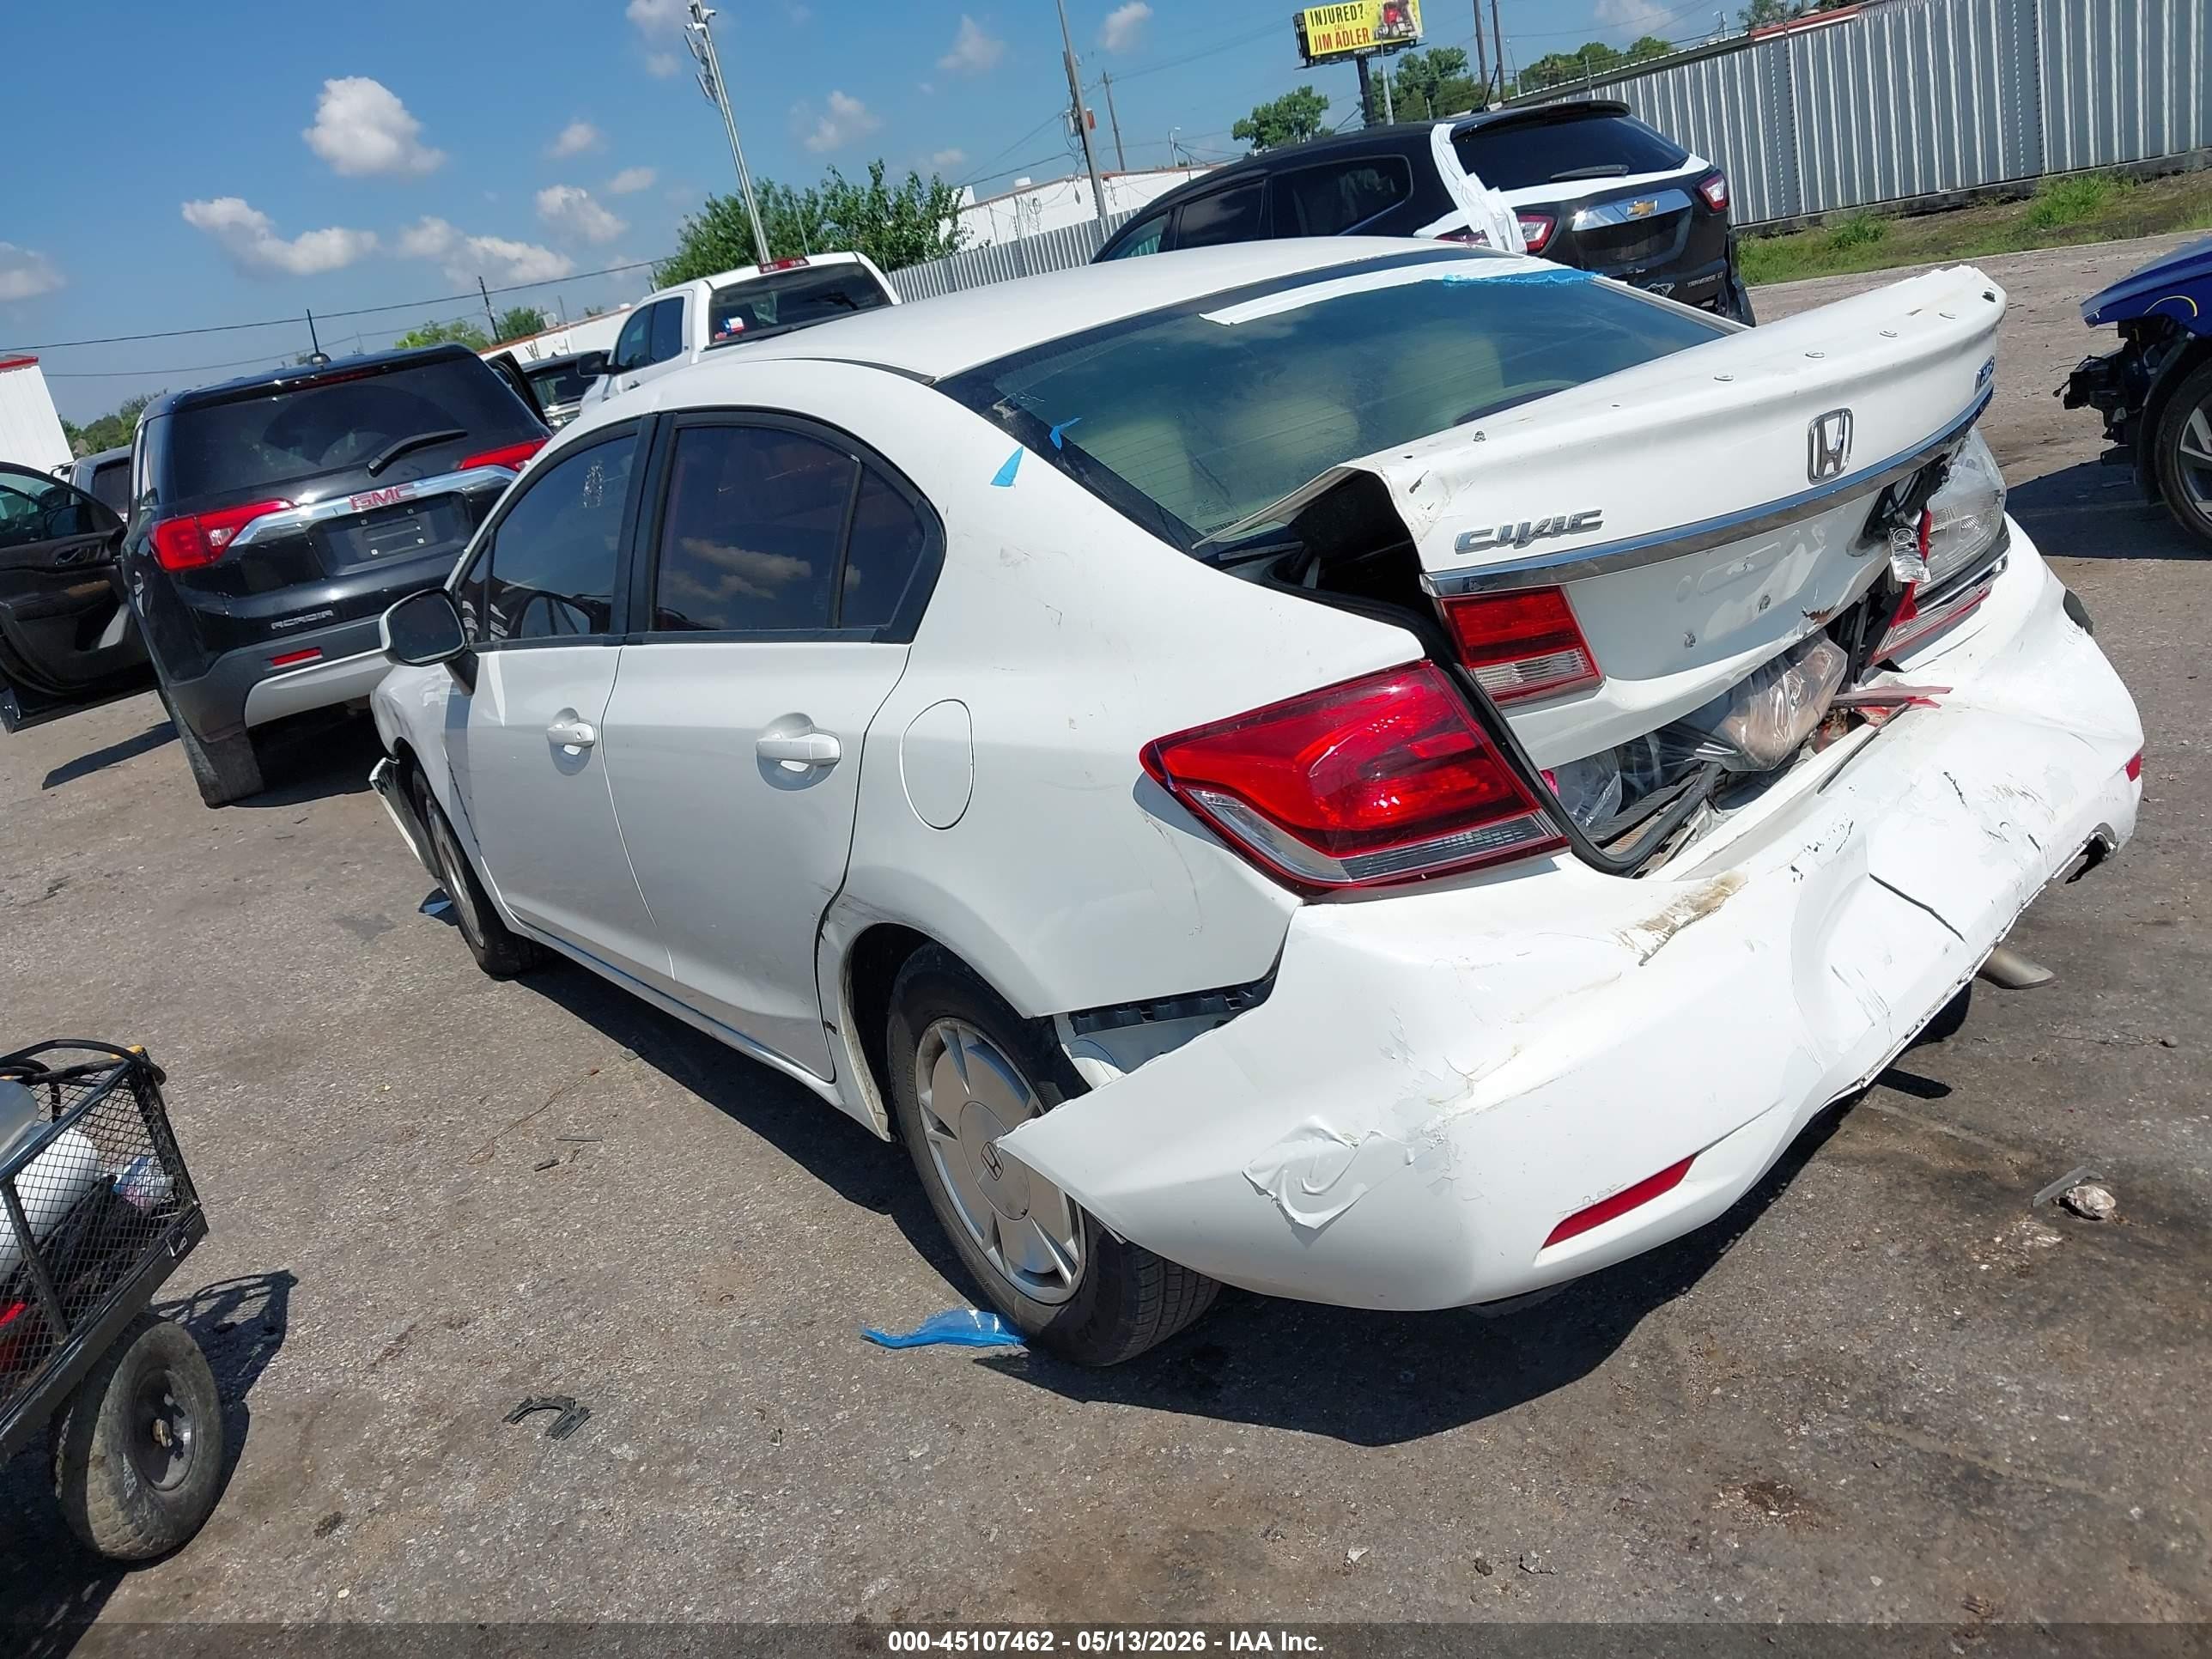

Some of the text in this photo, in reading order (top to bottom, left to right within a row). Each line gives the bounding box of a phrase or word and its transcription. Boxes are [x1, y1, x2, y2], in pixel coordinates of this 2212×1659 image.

[1310, 3, 1364, 27] INJURED?
[1334, 22, 1346, 31] CALL
[1314, 33, 1334, 52] JIM
[1335, 27, 1370, 49] ADLER
[349, 483, 414, 511] GMC
[1455, 509, 1604, 555] CIVIC
[270, 610, 334, 629] ACADIA
